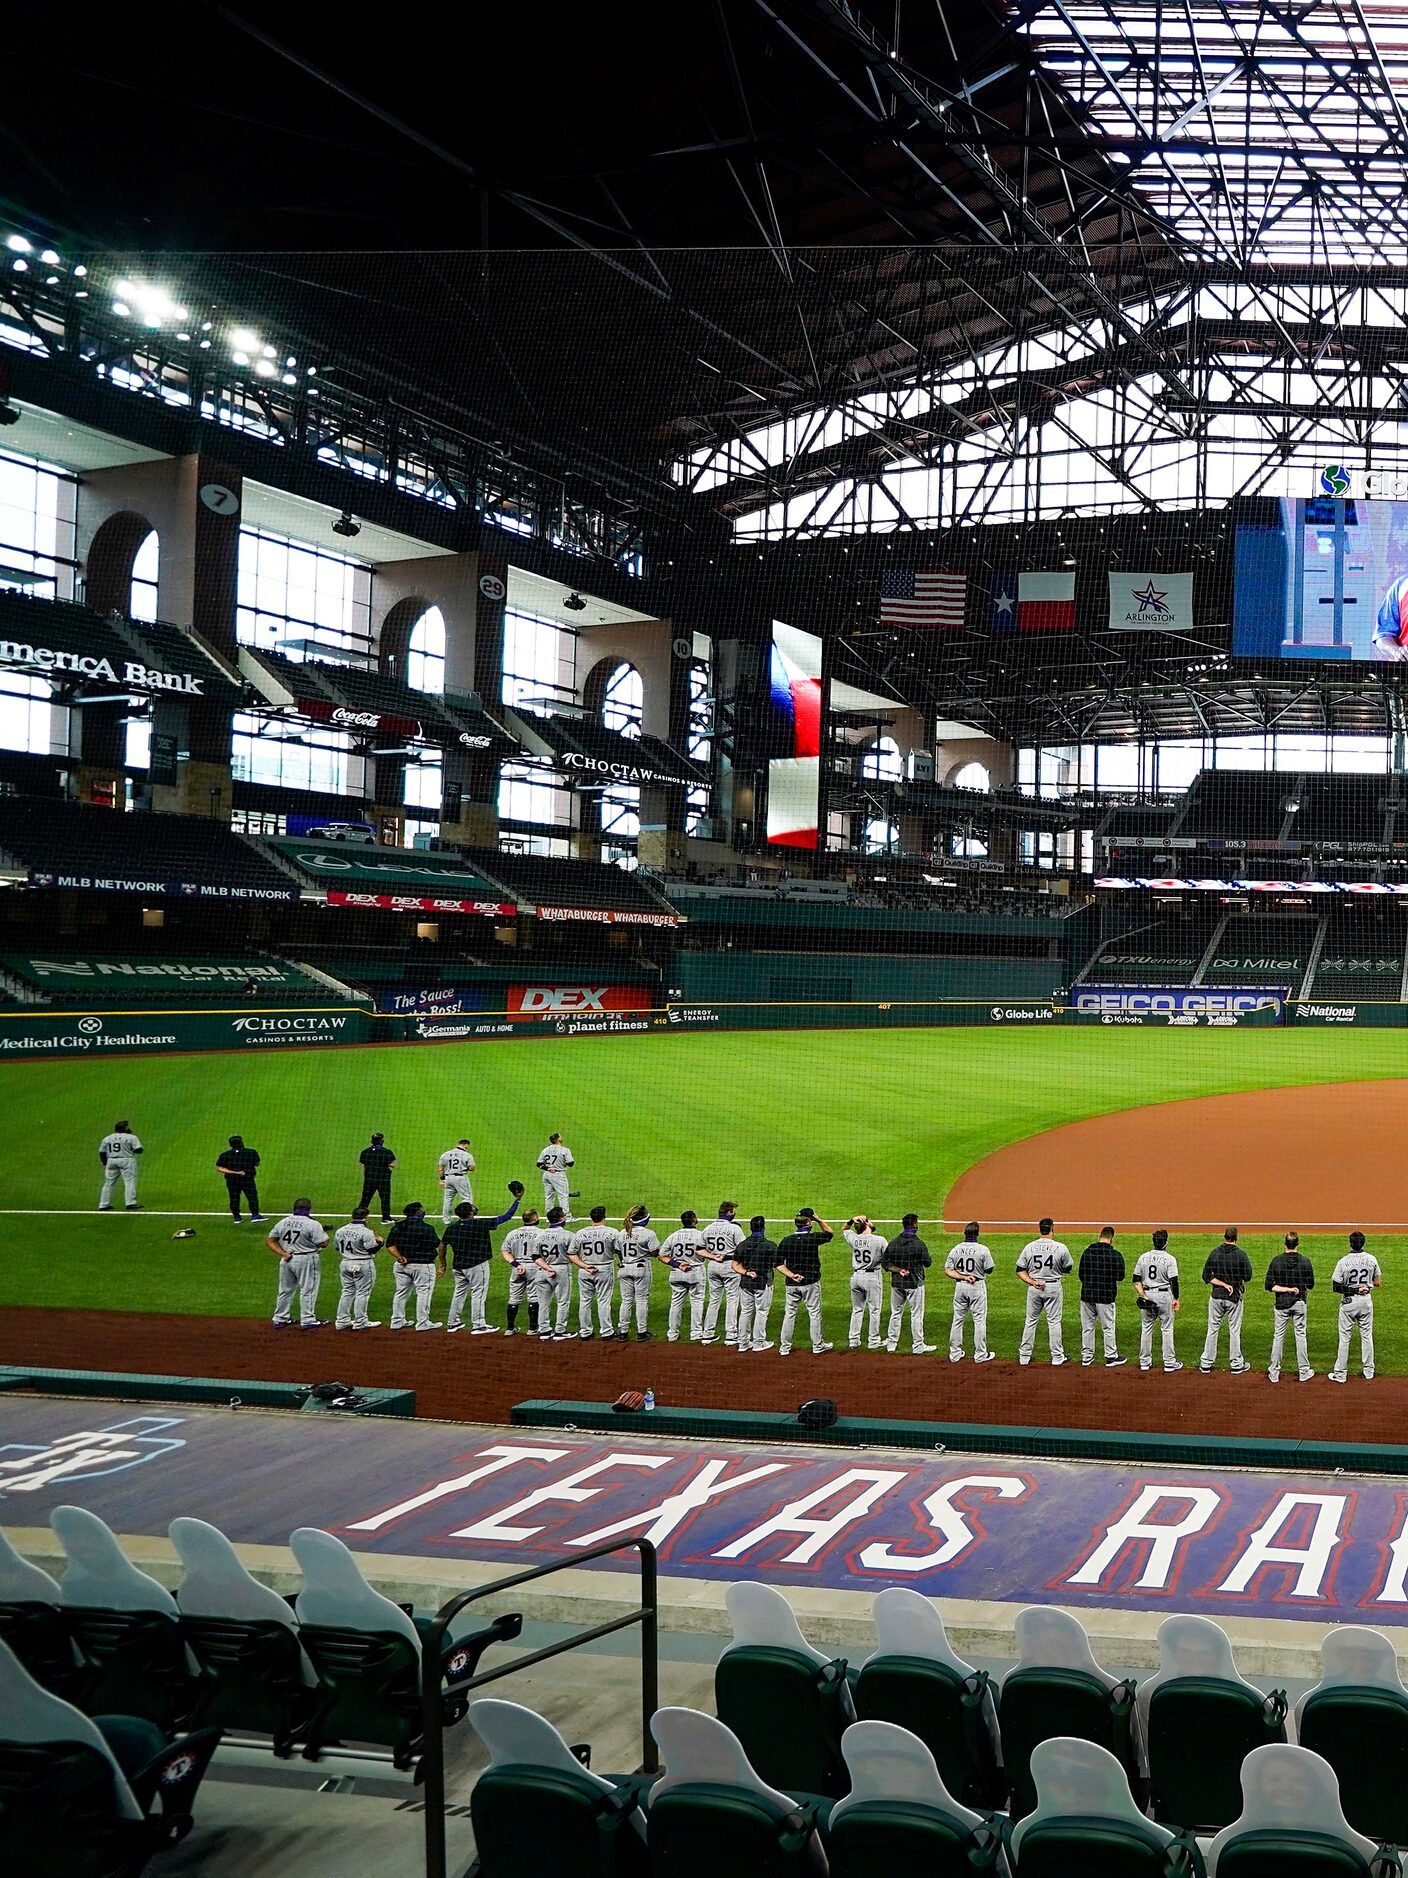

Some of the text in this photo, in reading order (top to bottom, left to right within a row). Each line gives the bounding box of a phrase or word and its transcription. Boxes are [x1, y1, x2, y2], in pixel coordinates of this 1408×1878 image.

[214, 491, 228, 507] 7
[482, 580, 503, 596] 29
[1125, 613, 1175, 622] ARLINGTON
[123, 661, 204, 695] Bank
[571, 752, 653, 781] CHOCTAW
[1224, 840, 1246, 848] 105.3
[353, 862, 475, 879] LEXUS
[58, 876, 166, 893] MLB NETWORK
[200, 886, 291, 900] MLB NETWORK
[345, 893, 379, 903] DEX
[391, 897, 422, 906] DEX
[433, 899, 463, 908] DEX
[473, 902, 500, 911] DEX
[541, 907, 675, 925] WHATABURGER WHATABURGER
[1243, 958, 1299, 970] Mitel
[393, 987, 455, 1010] The Sauce
[520, 987, 610, 1011] DEX
[1076, 993, 1281, 1018] GEICO GEICO
[429, 1000, 463, 1018] Boss!
[1005, 1009, 1053, 1019] Globe Life
[245, 1017, 347, 1030] CHOCTAW
[567, 1019, 649, 1034] planet fitness
[1113, 1015, 1143, 1024] Kubota
[430, 1025, 471, 1034] Germania
[475, 1025, 490, 1033] AUTO
[497, 1023, 514, 1032] HOME
[59, 1036, 92, 1048] City
[96, 1033, 176, 1046] Healthcare
[246, 1036, 288, 1044] CASINOS
[298, 1034, 334, 1042] RESORTS
[108, 1142, 121, 1153] 19
[448, 1158, 460, 1170] 12
[544, 1154, 559, 1167] 27
[282, 1230, 301, 1245] 47
[706, 1236, 726, 1252] 56
[340, 1239, 354, 1254] 14
[522, 1241, 528, 1256] 1
[539, 1243, 560, 1259] 64
[582, 1240, 605, 1256] 50
[622, 1242, 638, 1257] 15
[673, 1243, 695, 1258] 35
[853, 1249, 872, 1264] 26
[1033, 1254, 1054, 1270] 54
[955, 1257, 976, 1273] 40
[1148, 1264, 1157, 1280] 8
[1349, 1268, 1370, 1284] 22
[340, 1443, 1034, 1573] TEXAS
